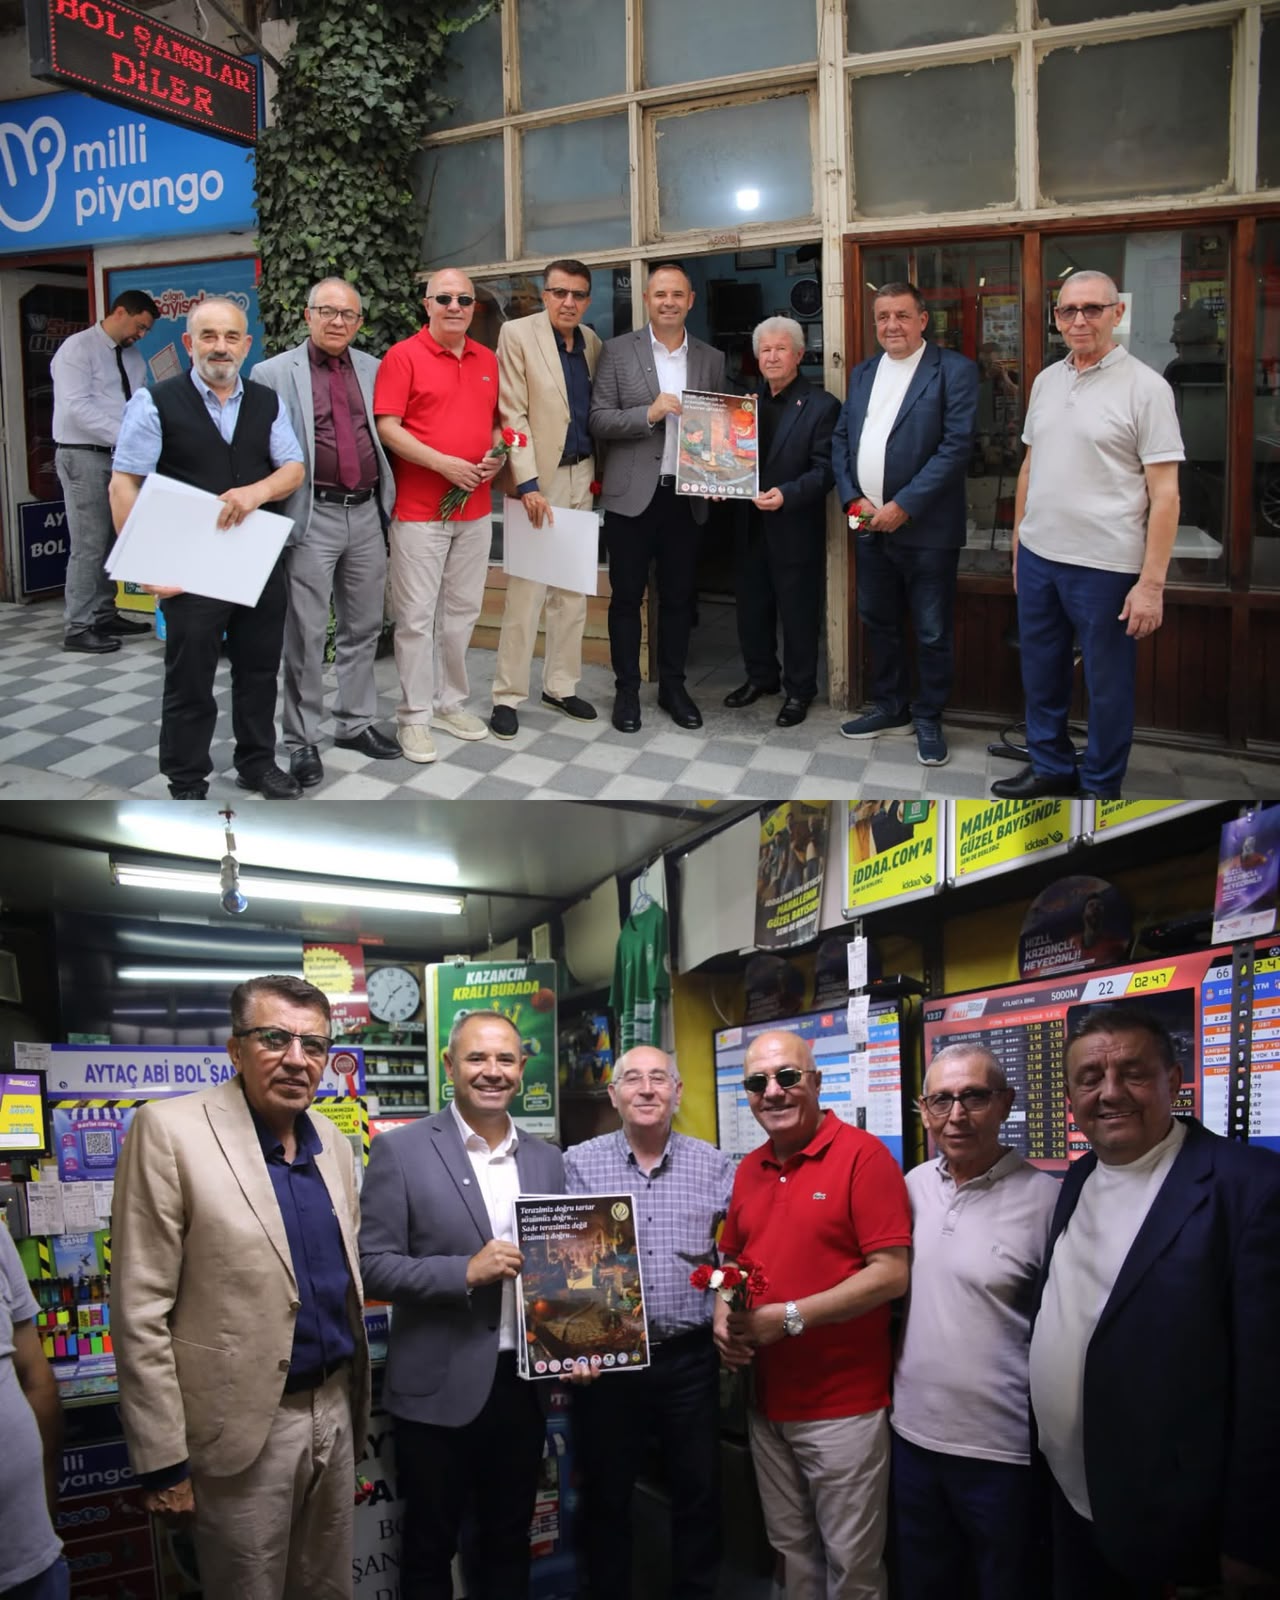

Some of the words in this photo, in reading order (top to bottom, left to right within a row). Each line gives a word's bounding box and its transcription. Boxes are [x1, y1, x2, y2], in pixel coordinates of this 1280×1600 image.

[56, 0, 124, 39] BOL
[133, 23, 251, 93] ŞANSLAR
[111, 53, 213, 116] DİLER
[74, 123, 147, 173] milli
[75, 170, 224, 226] piyango
[30, 540, 66, 557] BOL
[960, 829, 993, 856] GÜZEL
[1025, 837, 1048, 851] iddaa
[902, 877, 921, 889] iddaa
[465, 967, 527, 985] KAZANCIN
[1134, 973, 1167, 988] 02:47
[1216, 968, 1229, 979] 66
[453, 985, 488, 1001] KRALI
[490, 980, 540, 997] BURADA
[1051, 988, 1078, 1002] 5000M
[1098, 981, 1114, 996] 22
[85, 1064, 137, 1088] AYTAÇ
[143, 1060, 169, 1083] ABİ
[174, 1065, 206, 1083] BOL
[554, 1204, 574, 1215] doğru
[571, 1221, 588, 1230] değil
[63, 1454, 84, 1471] lli
[58, 1466, 135, 1493] yango
